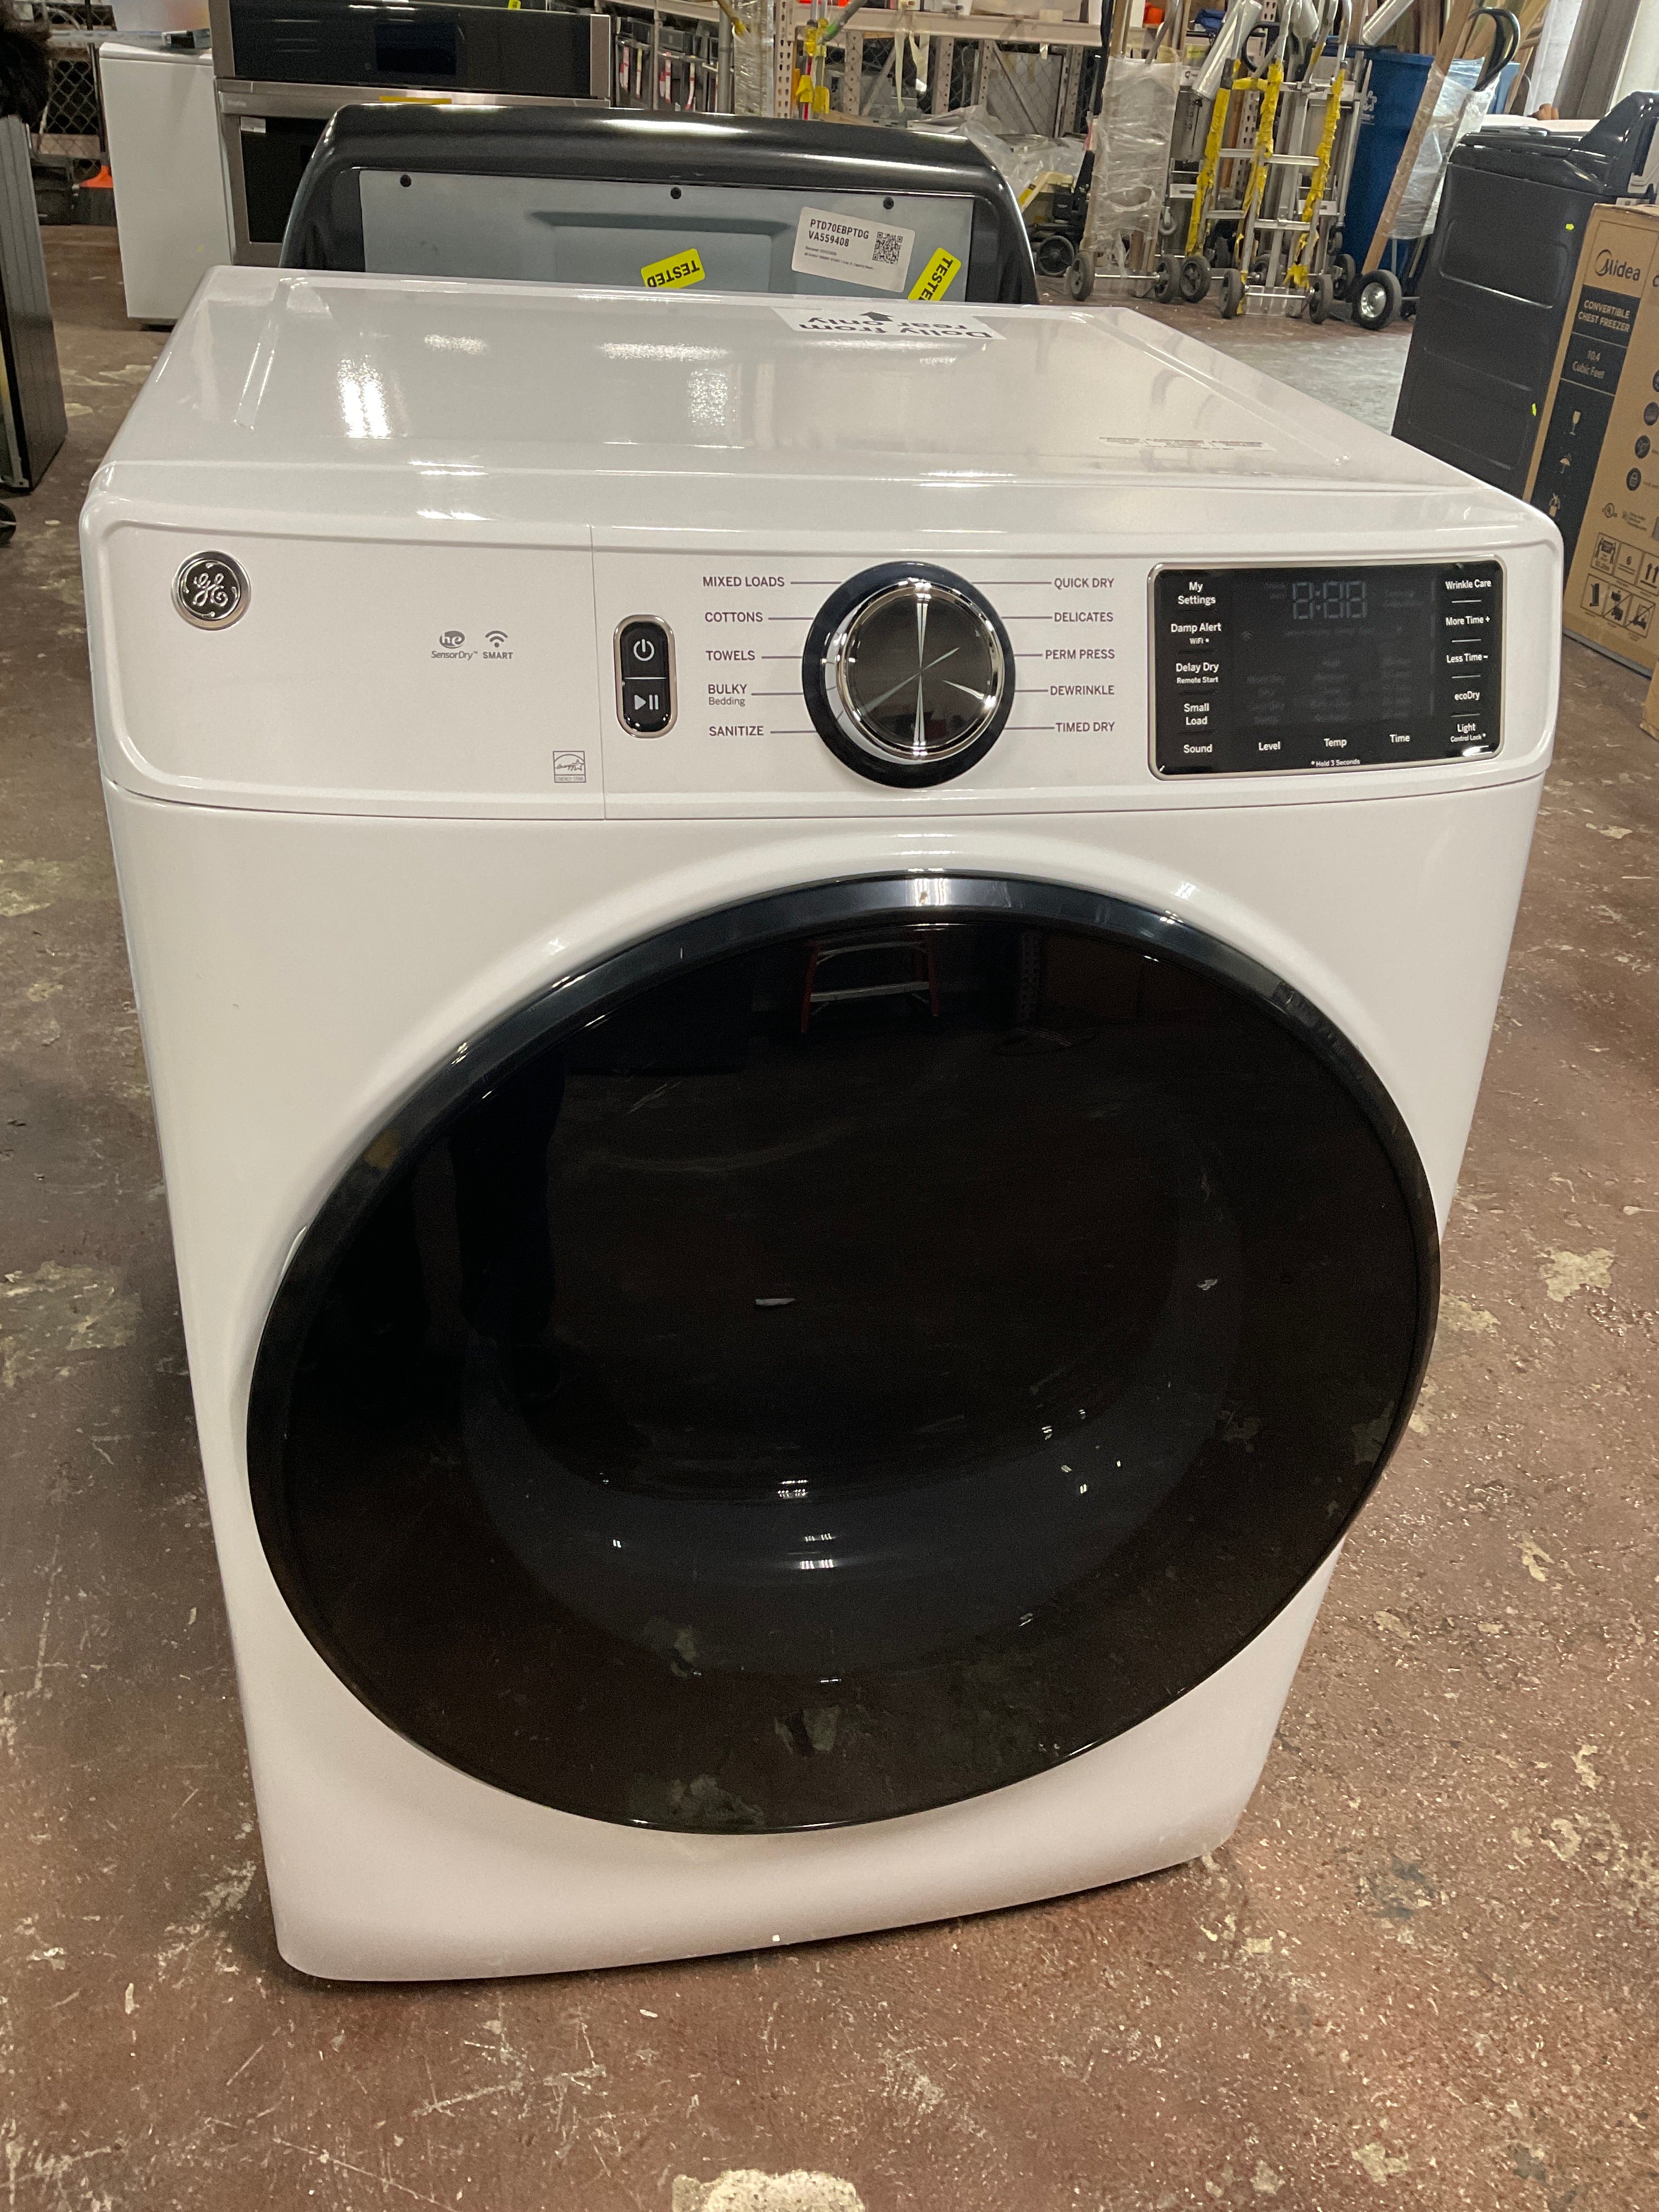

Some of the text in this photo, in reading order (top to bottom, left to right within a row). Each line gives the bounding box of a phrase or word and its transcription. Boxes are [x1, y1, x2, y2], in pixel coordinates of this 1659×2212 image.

[810, 219, 870, 240] PTD70EBPTDG
[809, 230, 850, 247] VA559408
[1595, 249, 1640, 281] Midea
[647, 260, 700, 287] TESTED
[918, 258, 953, 301] TESTE
[1584, 300, 1630, 319] CONVERTIBLE
[808, 317, 884, 326] only
[1578, 311, 1630, 333] CHEST FREEZER
[799, 324, 994, 338] Dolly from
[703, 576, 785, 587] MIXED LOADS
[1054, 578, 1114, 590] QUICK DRY
[1445, 579, 1492, 590] Wrinkle Care
[1189, 581, 1203, 594] My
[1177, 595, 1216, 606] Settings
[704, 612, 763, 623] COTTONS
[1054, 612, 1114, 622] DELICATES
[1446, 617, 1464, 626] More
[1465, 616, 1484, 625] Time
[1170, 622, 1222, 634] Damp Alert
[706, 650, 755, 661] TOWELS
[1045, 649, 1115, 660] PERM PRESS
[1446, 654, 1463, 663] Less
[1464, 653, 1482, 662] Time
[1176, 662, 1219, 673] Delay Dry
[708, 684, 747, 695] BULKY
[1050, 685, 1115, 696] DEWRINKLE
[1454, 691, 1480, 701] ecoDry
[708, 697, 746, 707] Bedding
[1184, 703, 1210, 712] Small
[1056, 721, 1115, 732] TIMED DRY
[1186, 716, 1207, 726] Load
[709, 726, 764, 737] SANITIZE
[1457, 723, 1476, 733] Light
[1324, 738, 1347, 748] Temp
[1390, 733, 1410, 743] Time
[1183, 744, 1212, 753] Sound
[1259, 741, 1281, 751] Level
